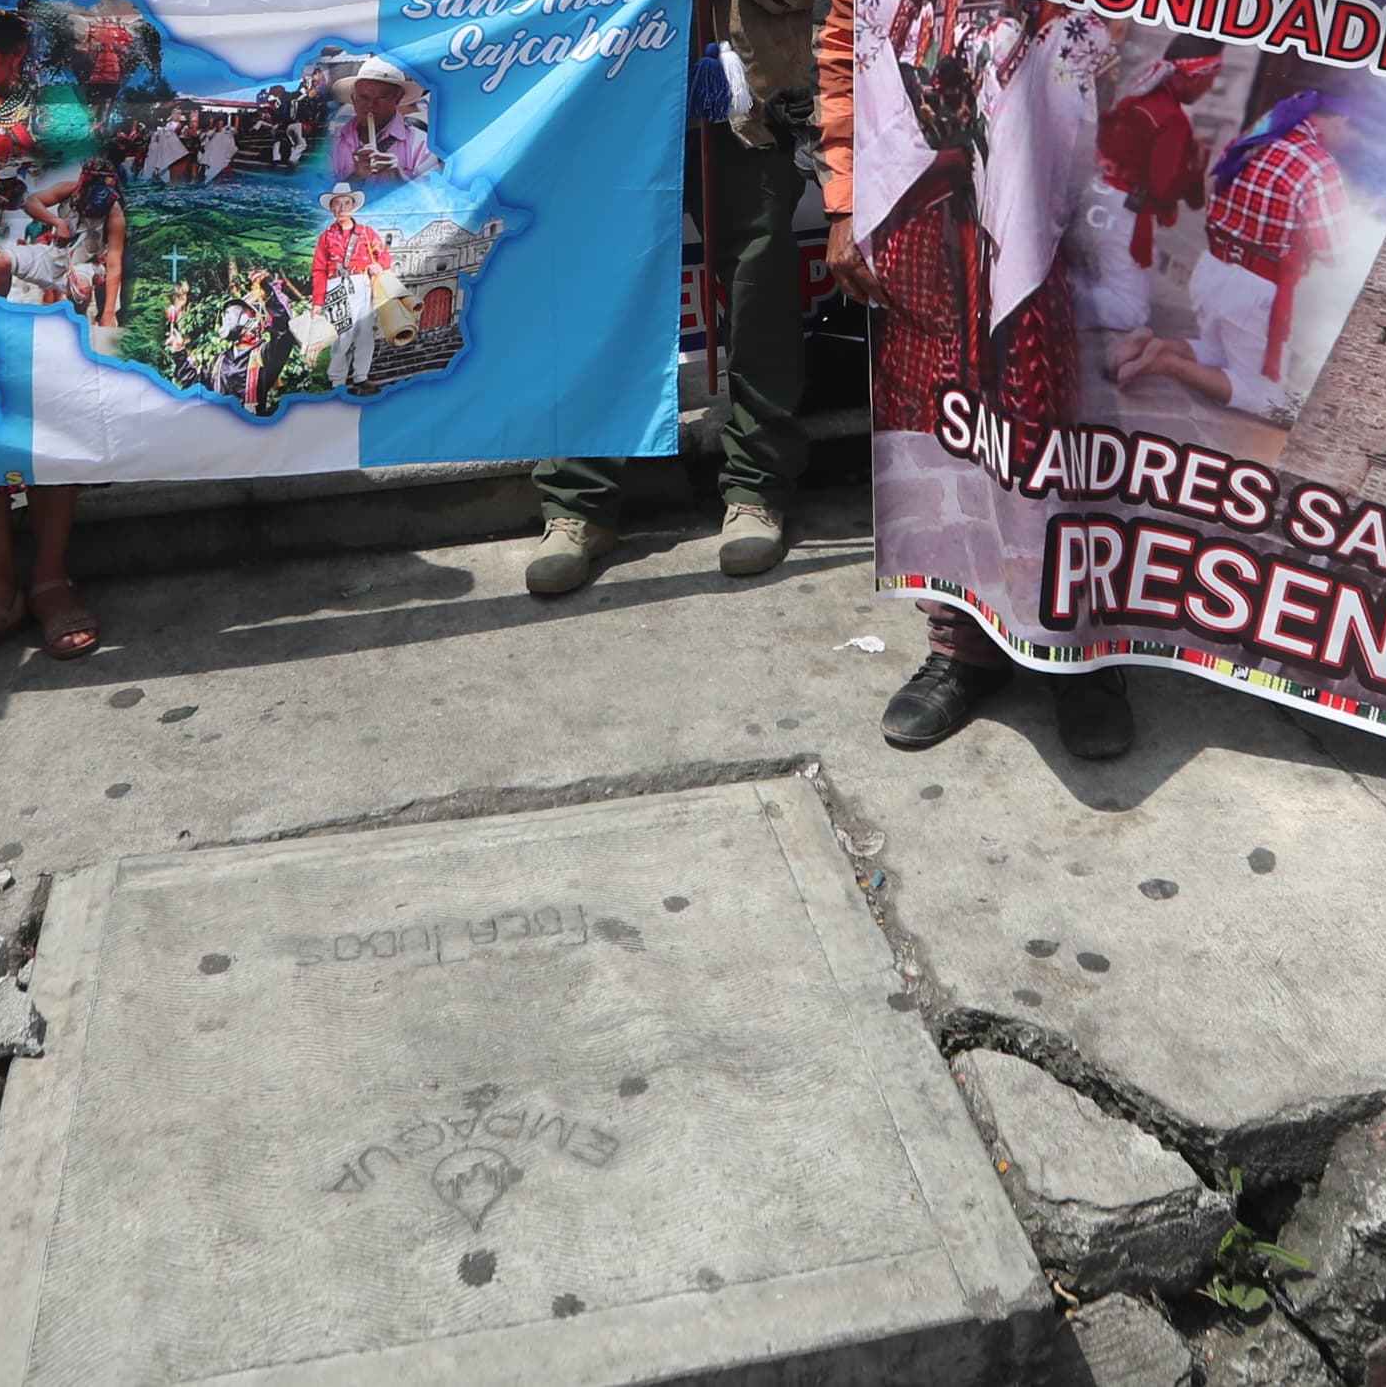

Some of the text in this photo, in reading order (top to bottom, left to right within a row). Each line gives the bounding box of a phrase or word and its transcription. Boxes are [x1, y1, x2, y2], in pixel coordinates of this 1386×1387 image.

[440, 9, 677, 94] Sajcabajá
[940, 389, 1012, 485] SAN
[1028, 427, 1274, 527] ANDRES
